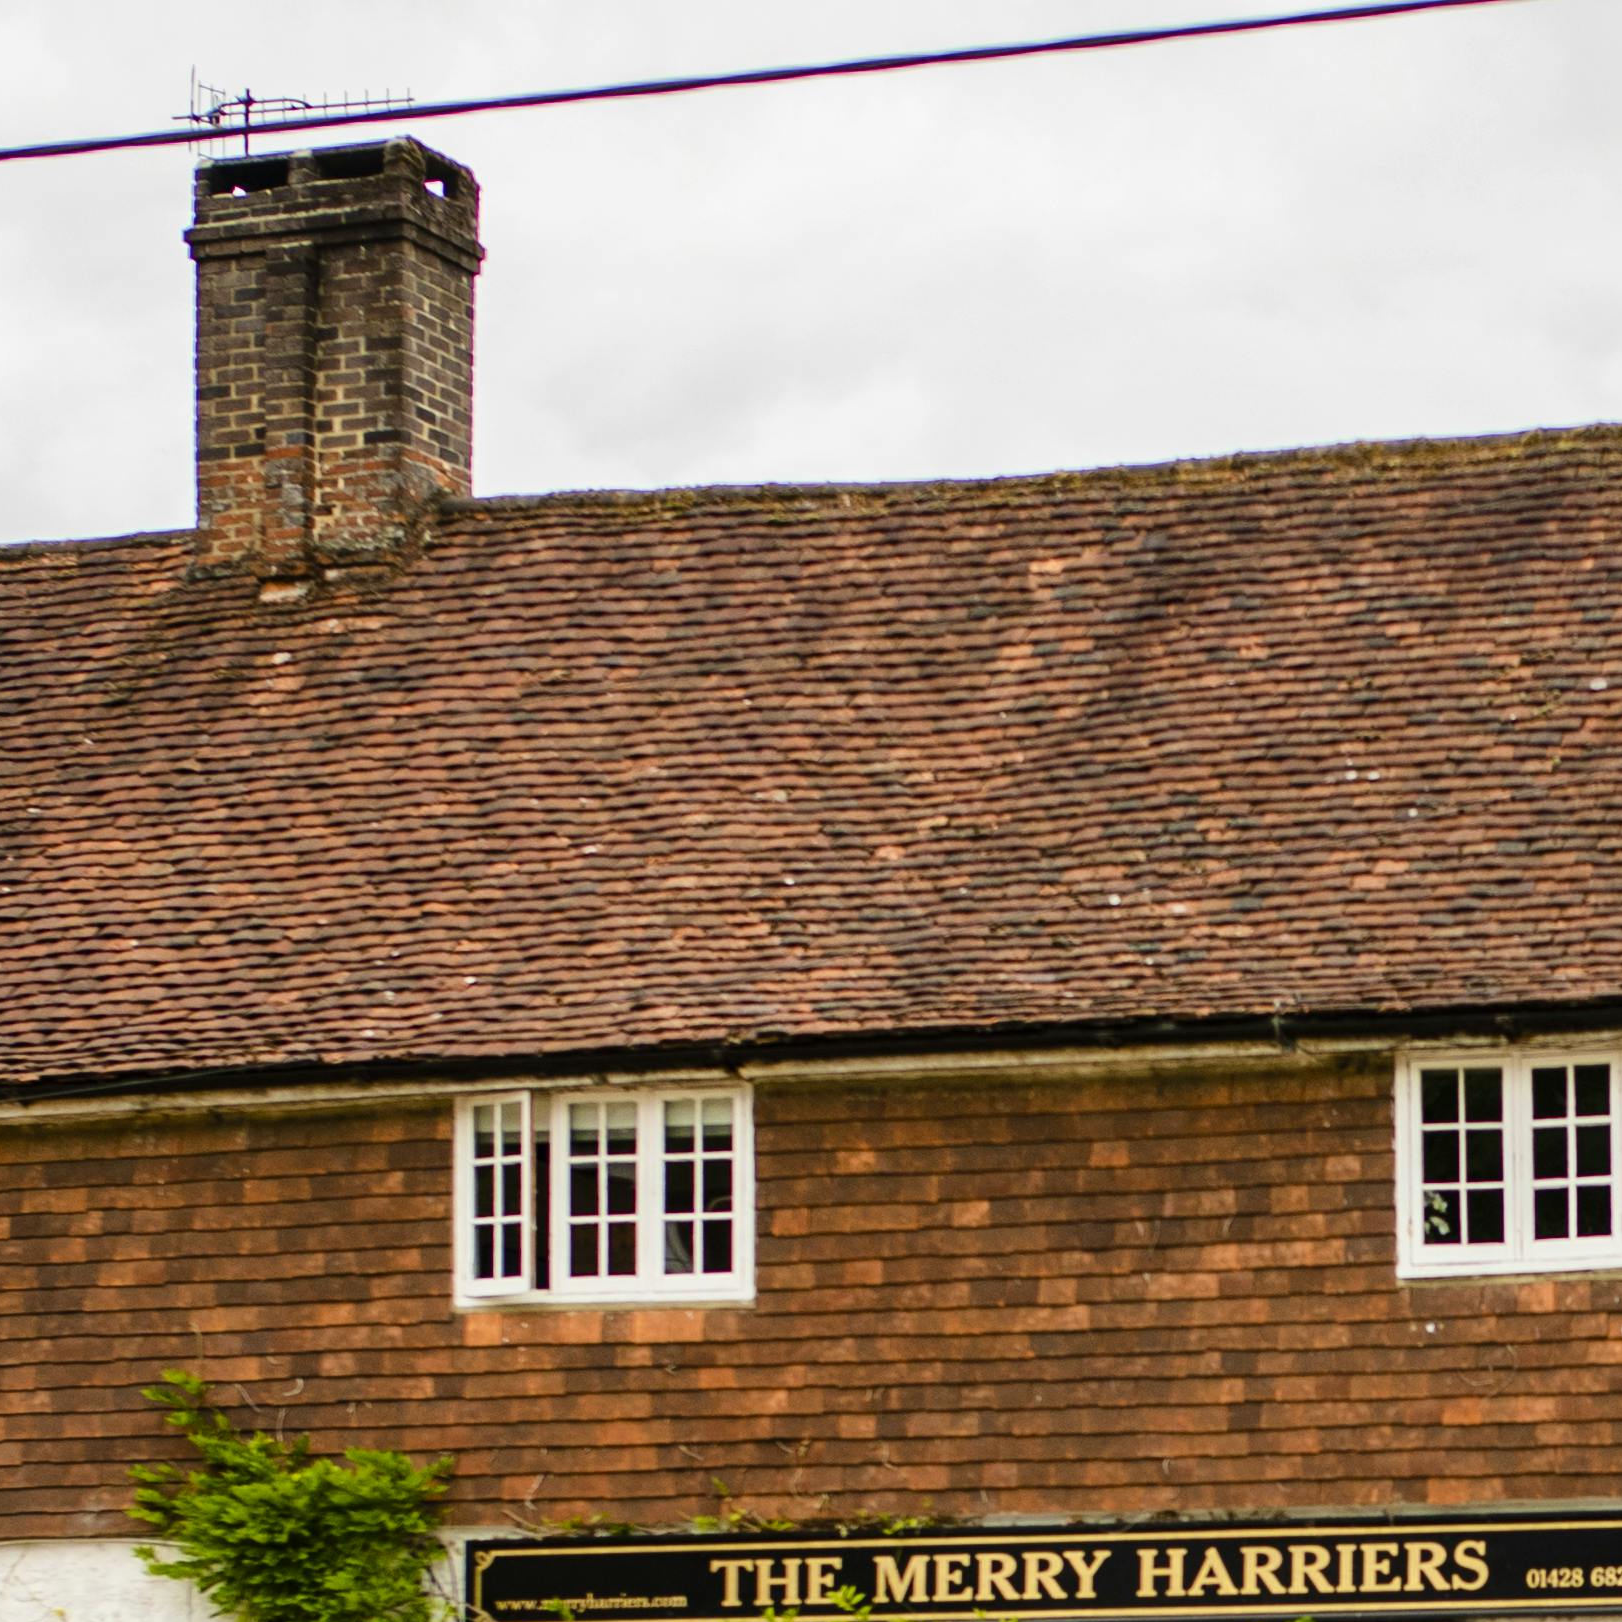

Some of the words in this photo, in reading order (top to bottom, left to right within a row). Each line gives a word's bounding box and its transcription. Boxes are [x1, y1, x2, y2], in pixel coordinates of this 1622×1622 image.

[710, 1557, 843, 1607] THE
[872, 1550, 1112, 1604] MERRY
[1136, 1540, 1490, 1598] HARRIERS
[1526, 1567, 1584, 1589] 01428
[495, 1592, 688, 1613] www.mrryharriers.com
